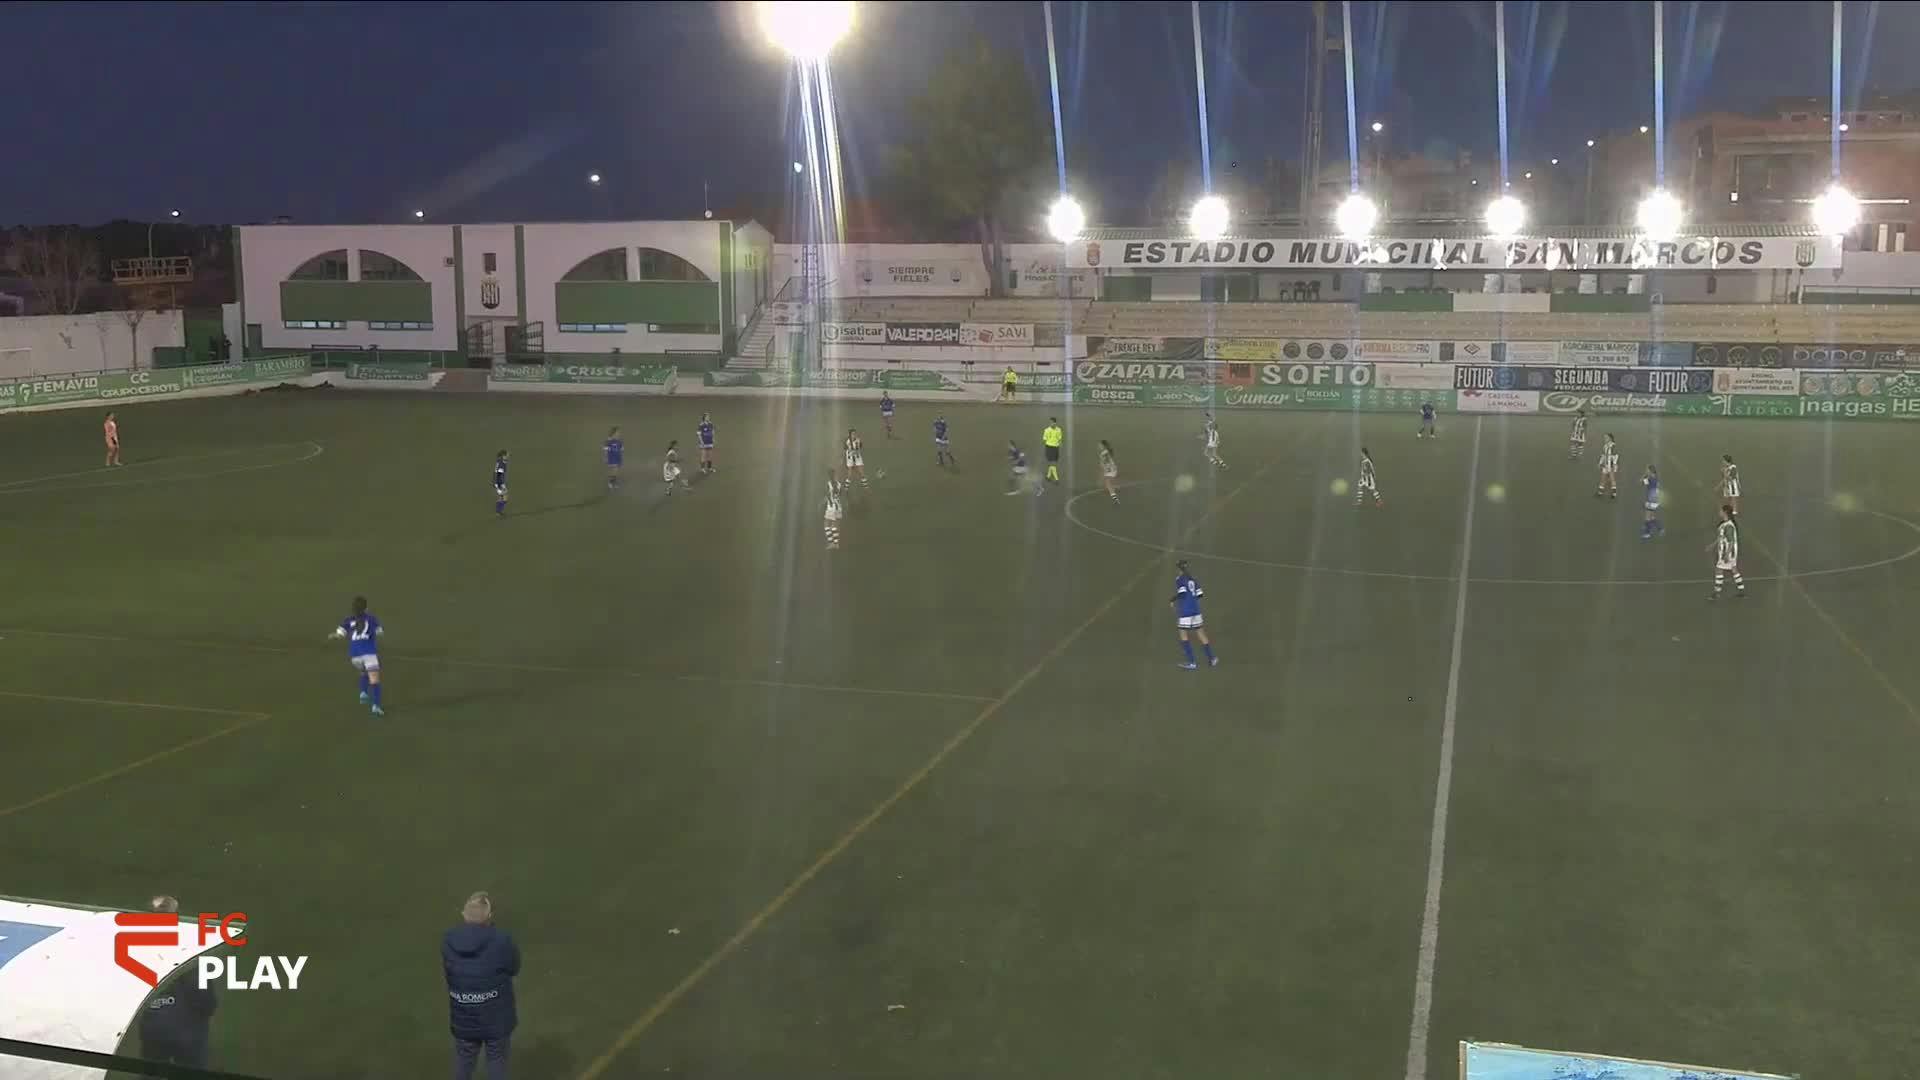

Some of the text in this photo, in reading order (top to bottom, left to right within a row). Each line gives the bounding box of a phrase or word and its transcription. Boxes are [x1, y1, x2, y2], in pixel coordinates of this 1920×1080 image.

[1123, 241, 1275, 264] ESTADIO
[1289, 241, 1488, 264] MUNCIAL
[1504, 241, 1581, 265] SAN
[888, 266, 935, 274] SIEMPRE
[893, 275, 930, 283] FIELES
[998, 327, 1027, 338] SAVI
[1097, 364, 1185, 379] ZAPATA
[1261, 364, 1370, 386] SOFIO
[1554, 369, 1609, 385] SEGUNDA
[1648, 371, 1689, 392] FUTUR
[462, 990, 498, 1001] ROMERO
